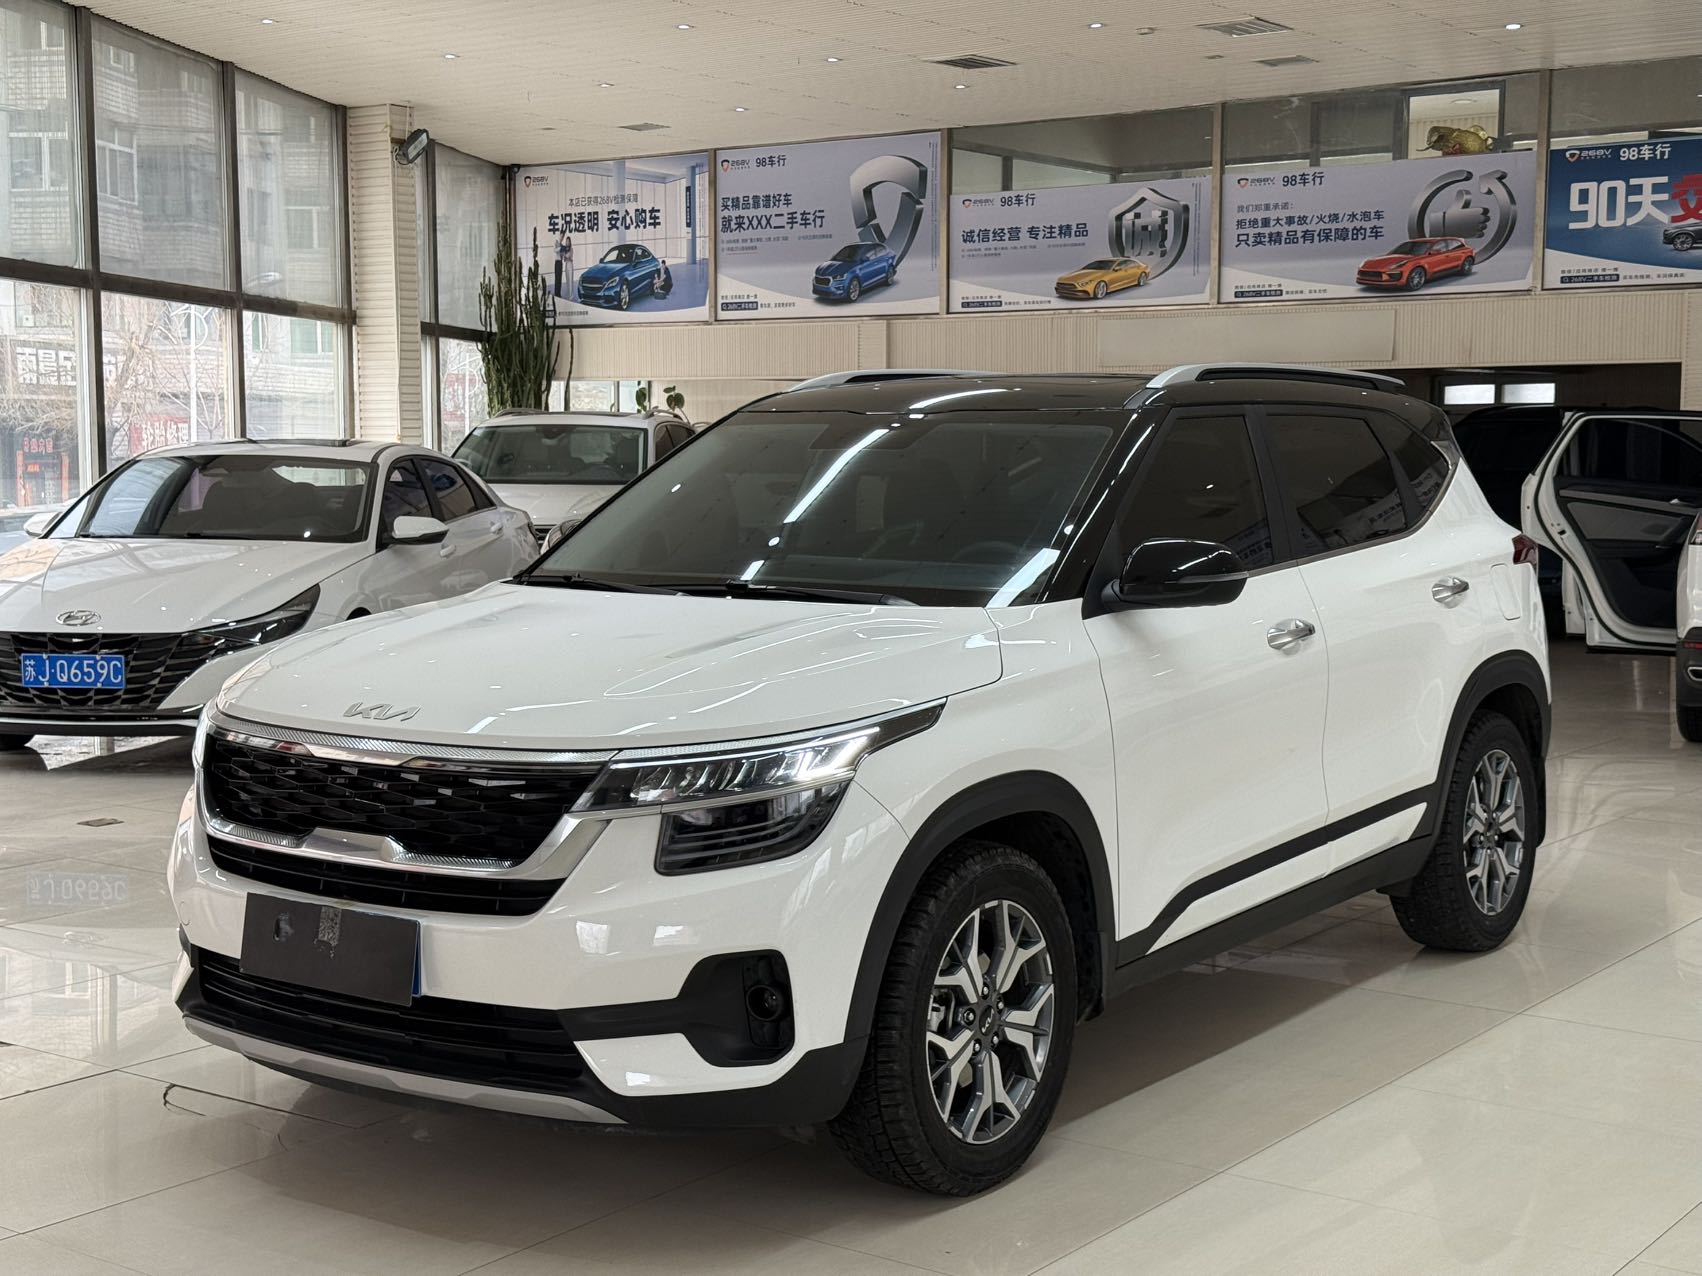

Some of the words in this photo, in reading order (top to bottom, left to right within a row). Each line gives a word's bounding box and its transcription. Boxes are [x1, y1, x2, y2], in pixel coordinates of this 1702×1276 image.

[756, 154, 786, 168] 98车行
[1620, 143, 1672, 161] 98车行
[1282, 172, 1325, 187] 98车行
[568, 193, 639, 207] 本店已获得268V检测保障
[721, 193, 793, 212] 买精品靠谱好车
[1000, 193, 1037, 207] 98车行
[547, 211, 600, 234] 车况透明
[607, 206, 661, 230] 安心购车
[720, 209, 825, 233] 就来XXX二手车行
[1235, 209, 1385, 230] 拒绝重大事故/火烧/水泡车
[962, 226, 1022, 244] 诚信经营
[1027, 222, 1089, 240] 专注精品
[1235, 225, 1385, 248] 只卖精品有保障的车
